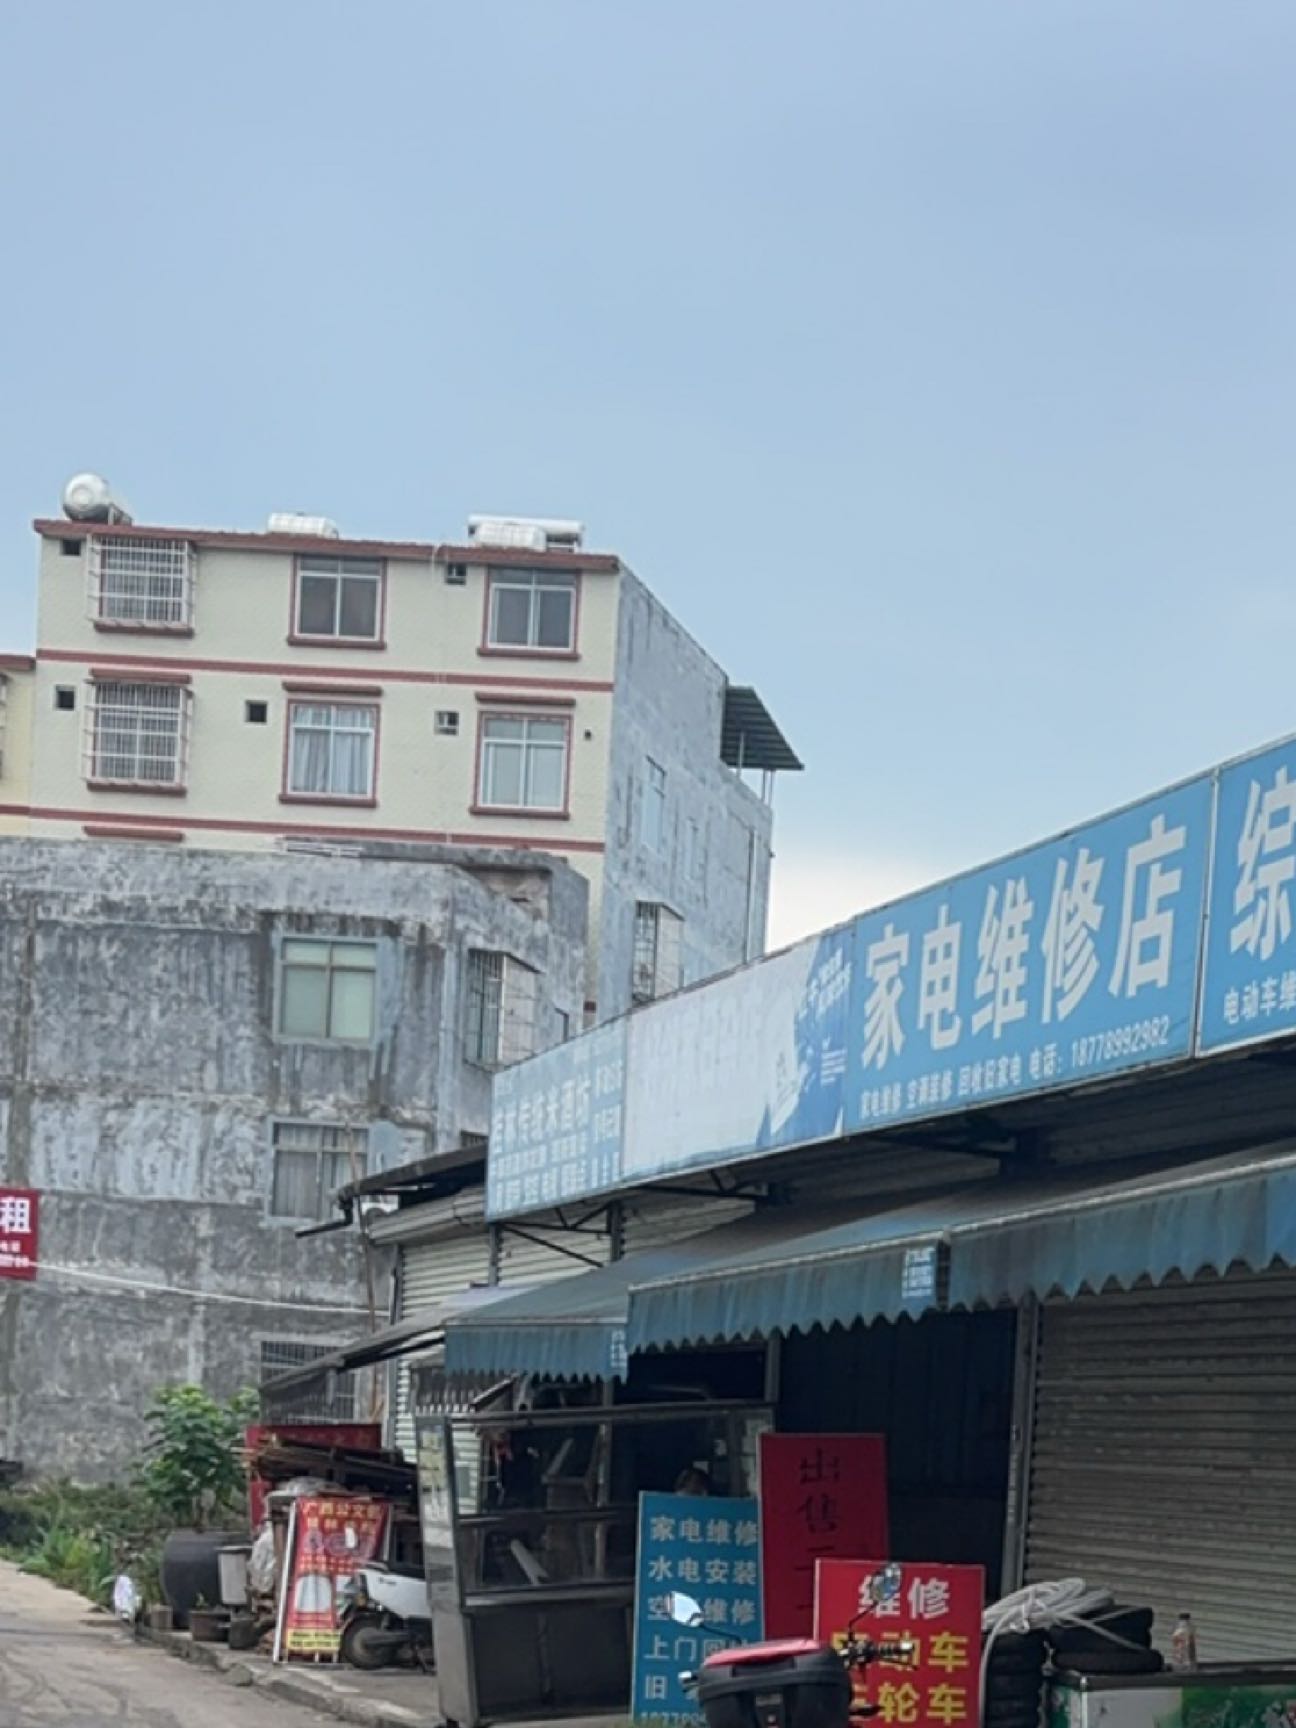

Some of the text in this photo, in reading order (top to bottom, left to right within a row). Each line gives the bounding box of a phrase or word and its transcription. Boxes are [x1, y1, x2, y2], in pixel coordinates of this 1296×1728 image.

[861, 813, 1188, 1070] 家电维修店
[650, 1515, 759, 1547] 家电维修
[648, 1556, 758, 1586] 水电安装
[648, 1597, 756, 1626] 空维修
[644, 1633, 750, 1663] 上门回
